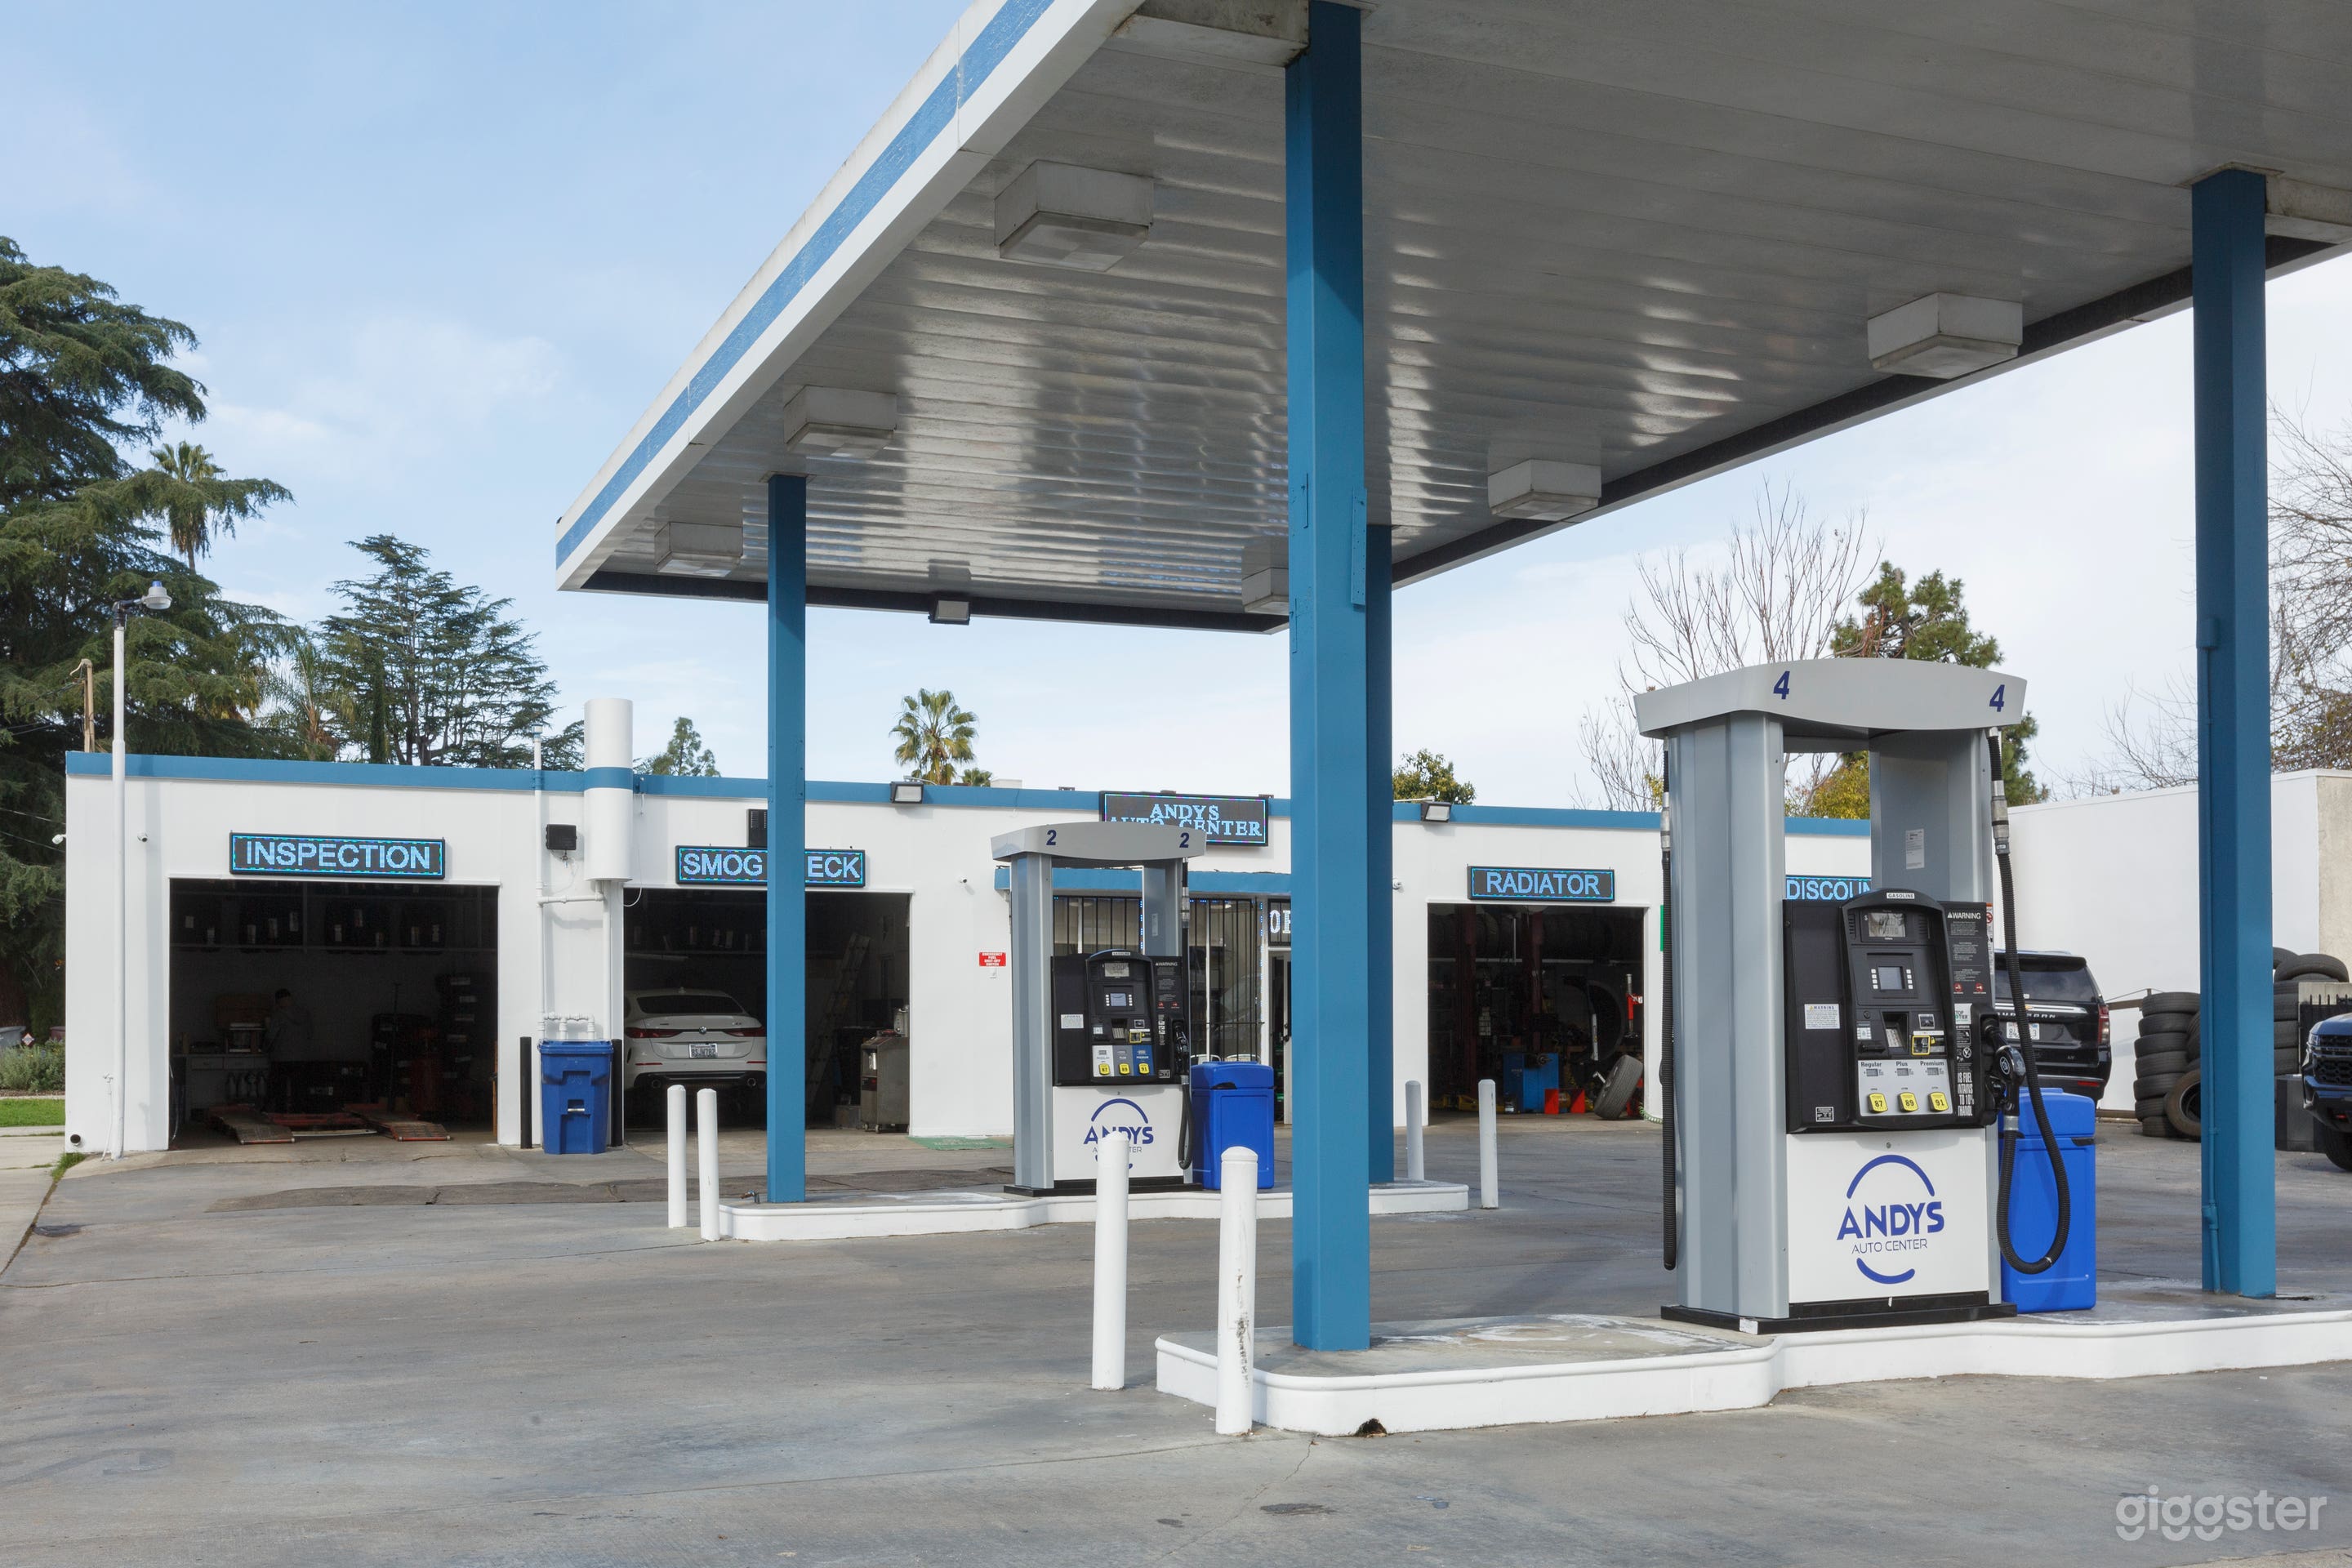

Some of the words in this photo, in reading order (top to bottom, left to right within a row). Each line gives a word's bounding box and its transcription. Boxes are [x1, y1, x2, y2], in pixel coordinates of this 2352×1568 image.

[1773, 670, 1790, 700] 4
[1989, 684, 2005, 712] 4
[1149, 804, 1219, 820] ANDYS
[1046, 830, 1057, 846] 2
[1179, 832, 1190, 849] 2
[247, 840, 430, 869] INSPECTION
[683, 853, 763, 876] SMOG
[807, 856, 860, 879] ECK
[1486, 871, 1601, 895] RADIATOR
[1952, 911, 1981, 920] WARNING
[1837, 1201, 1944, 1241] ANDYS
[1851, 1242, 1882, 1254] AUTO
[1885, 1239, 1927, 1251] CENTER
